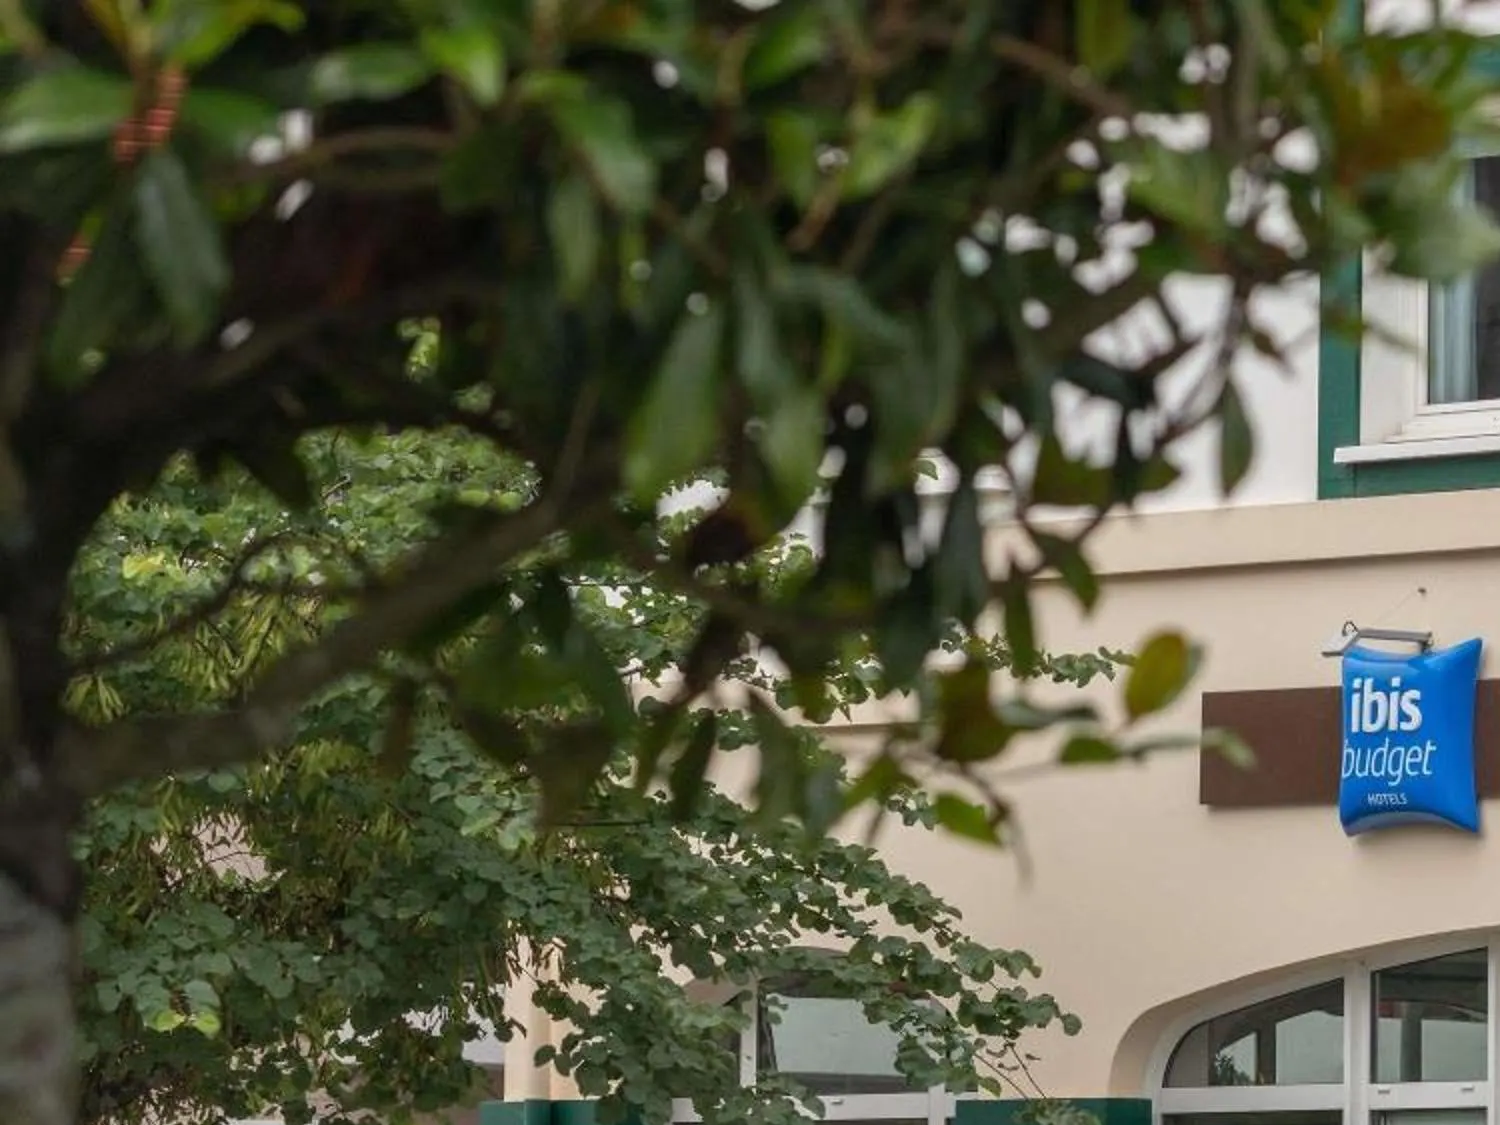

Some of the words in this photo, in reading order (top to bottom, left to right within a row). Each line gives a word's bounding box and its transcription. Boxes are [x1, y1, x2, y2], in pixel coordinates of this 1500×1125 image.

[1351, 676, 1423, 734] ibis
[1341, 737, 1438, 787] budget
[1367, 792, 1408, 805] HOTELS
